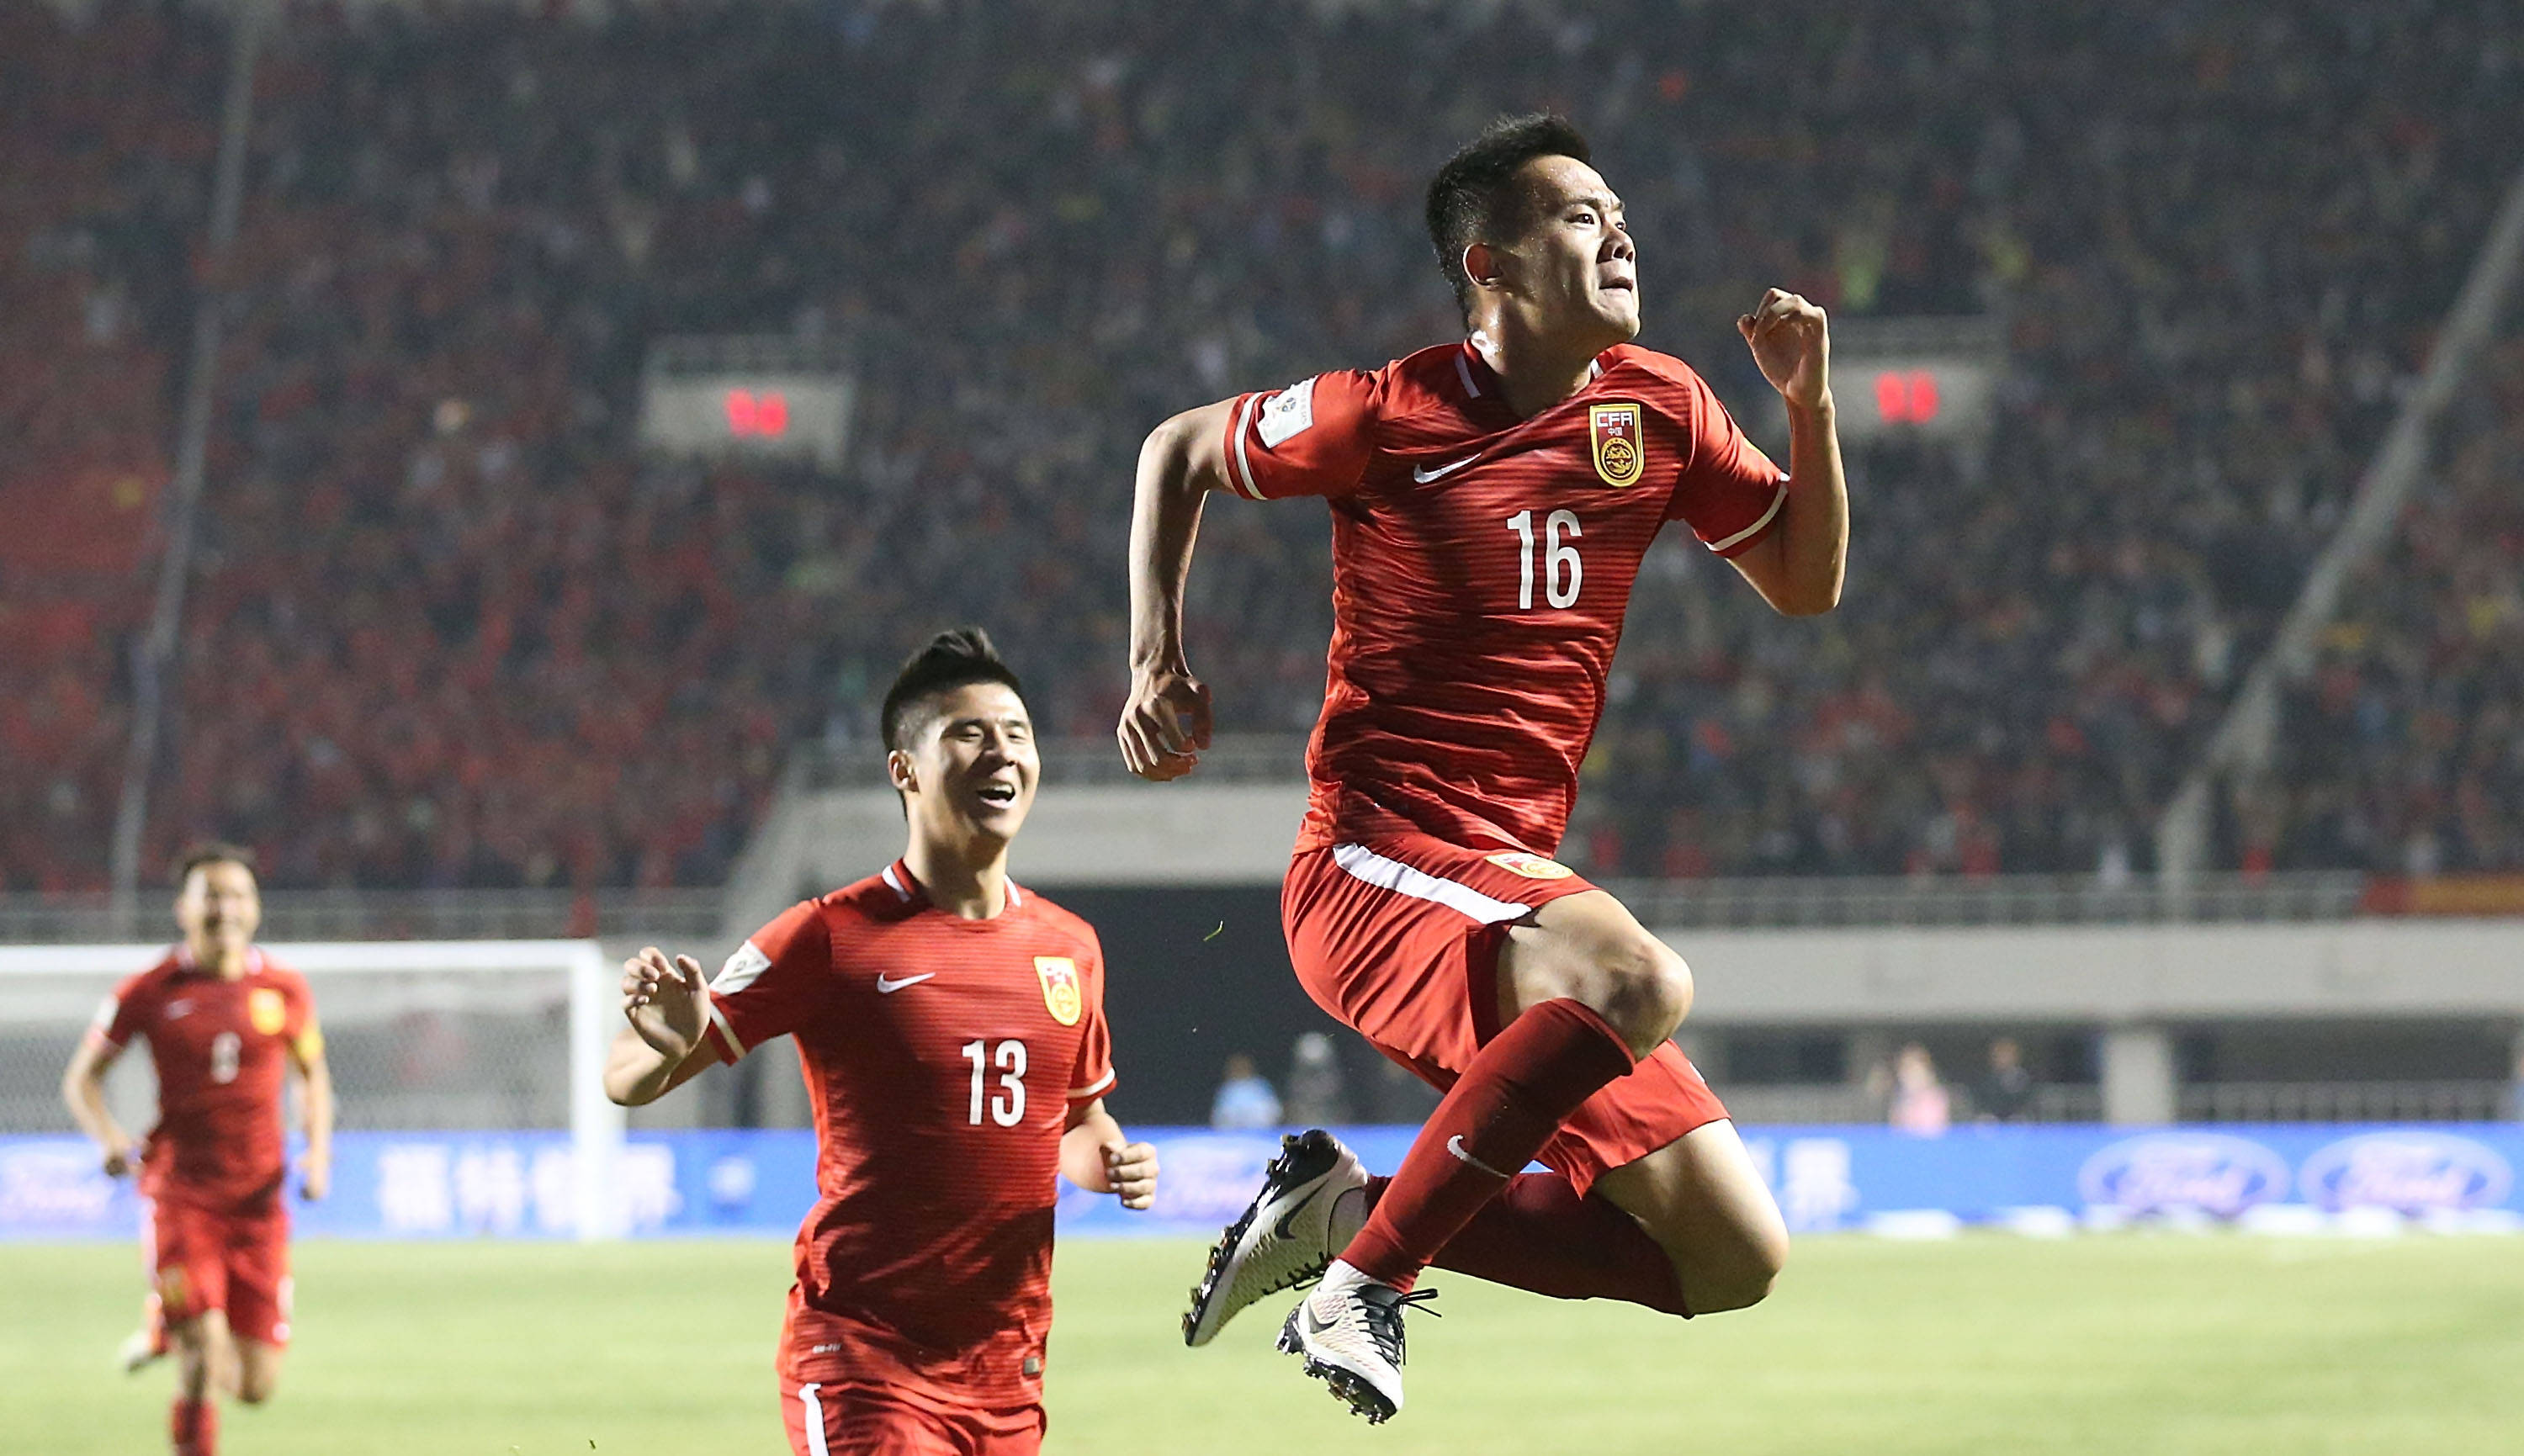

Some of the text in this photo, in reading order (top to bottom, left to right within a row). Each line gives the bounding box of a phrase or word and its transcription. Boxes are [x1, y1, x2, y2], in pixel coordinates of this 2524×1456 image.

[1596, 412, 1633, 426] CFA
[1507, 509, 1583, 610] 16
[962, 1039, 1027, 1127] 13
